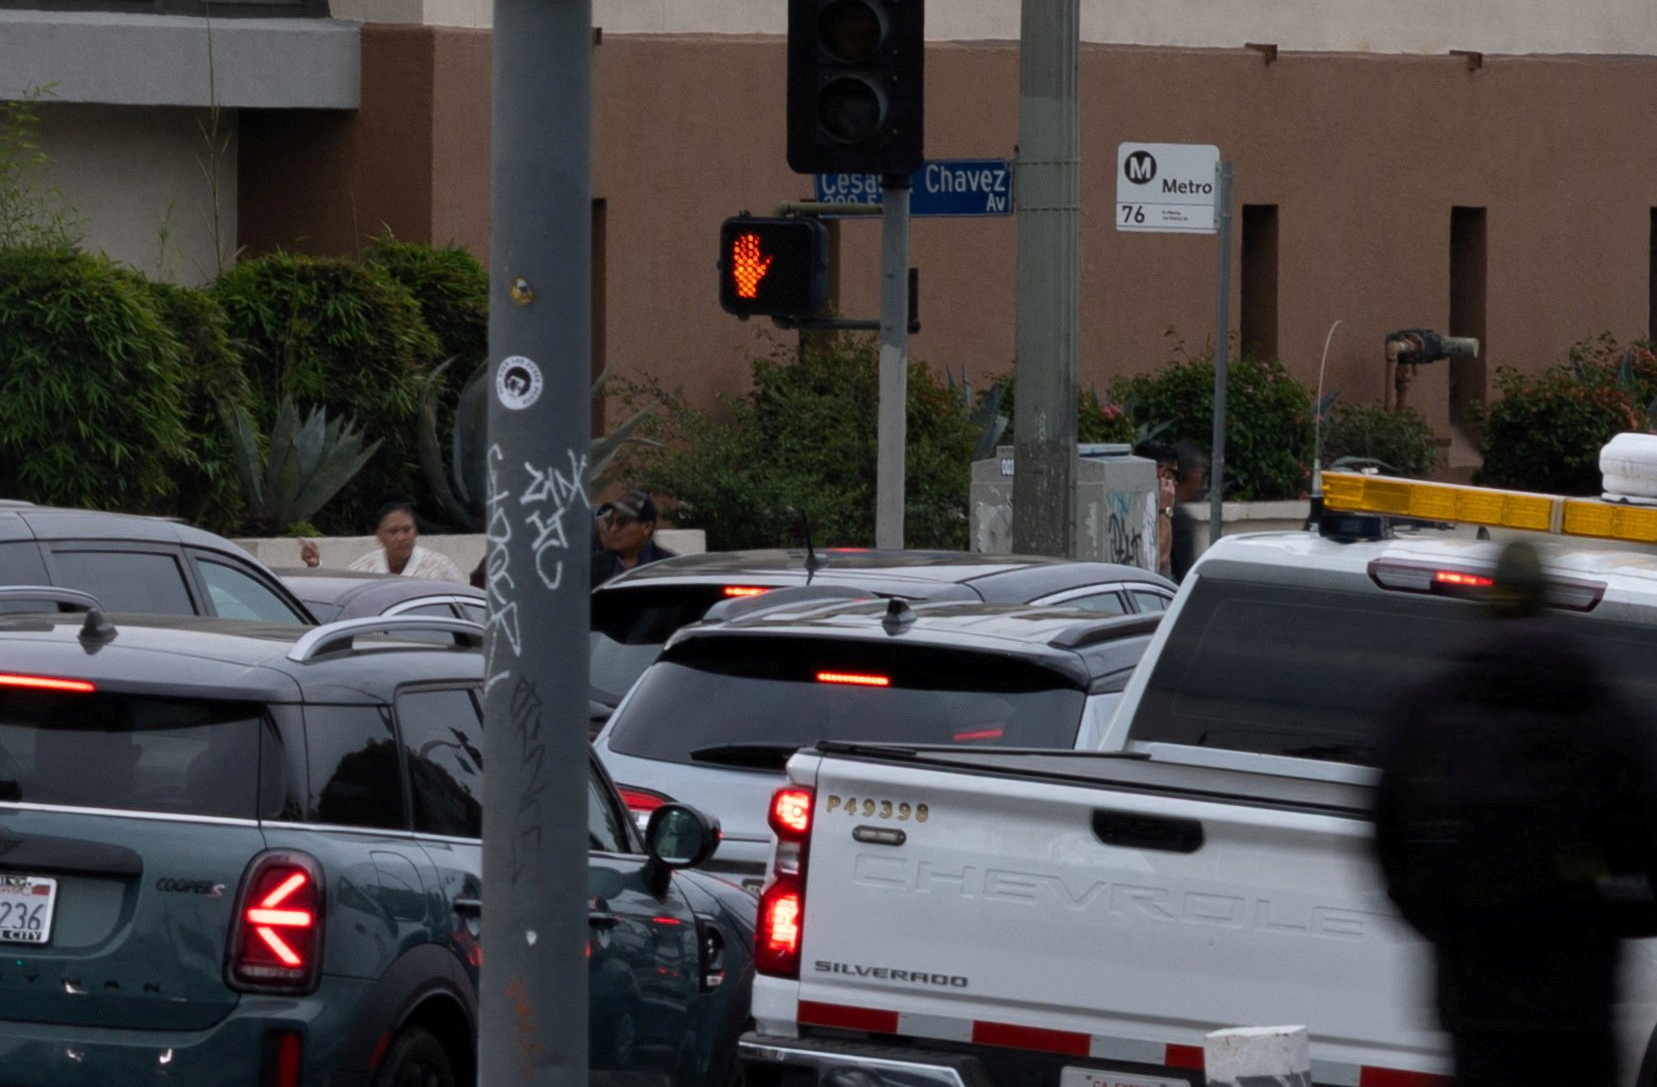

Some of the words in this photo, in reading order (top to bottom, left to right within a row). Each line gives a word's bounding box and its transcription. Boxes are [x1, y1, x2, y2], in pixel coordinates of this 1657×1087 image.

[821, 173, 884, 195] Cesa
[925, 164, 1006, 193] Chavez
[1161, 178, 1213, 195] Metro
[985, 193, 1006, 212] Av
[1121, 204, 1146, 224] 76
[826, 794, 931, 823] P49398
[155, 877, 212, 893] COOPER
[852, 852, 1368, 943] CHEVROLE
[0, 901, 45, 930] 236
[8, 930, 43, 941] CITY
[814, 960, 969, 988] SILVERADO
